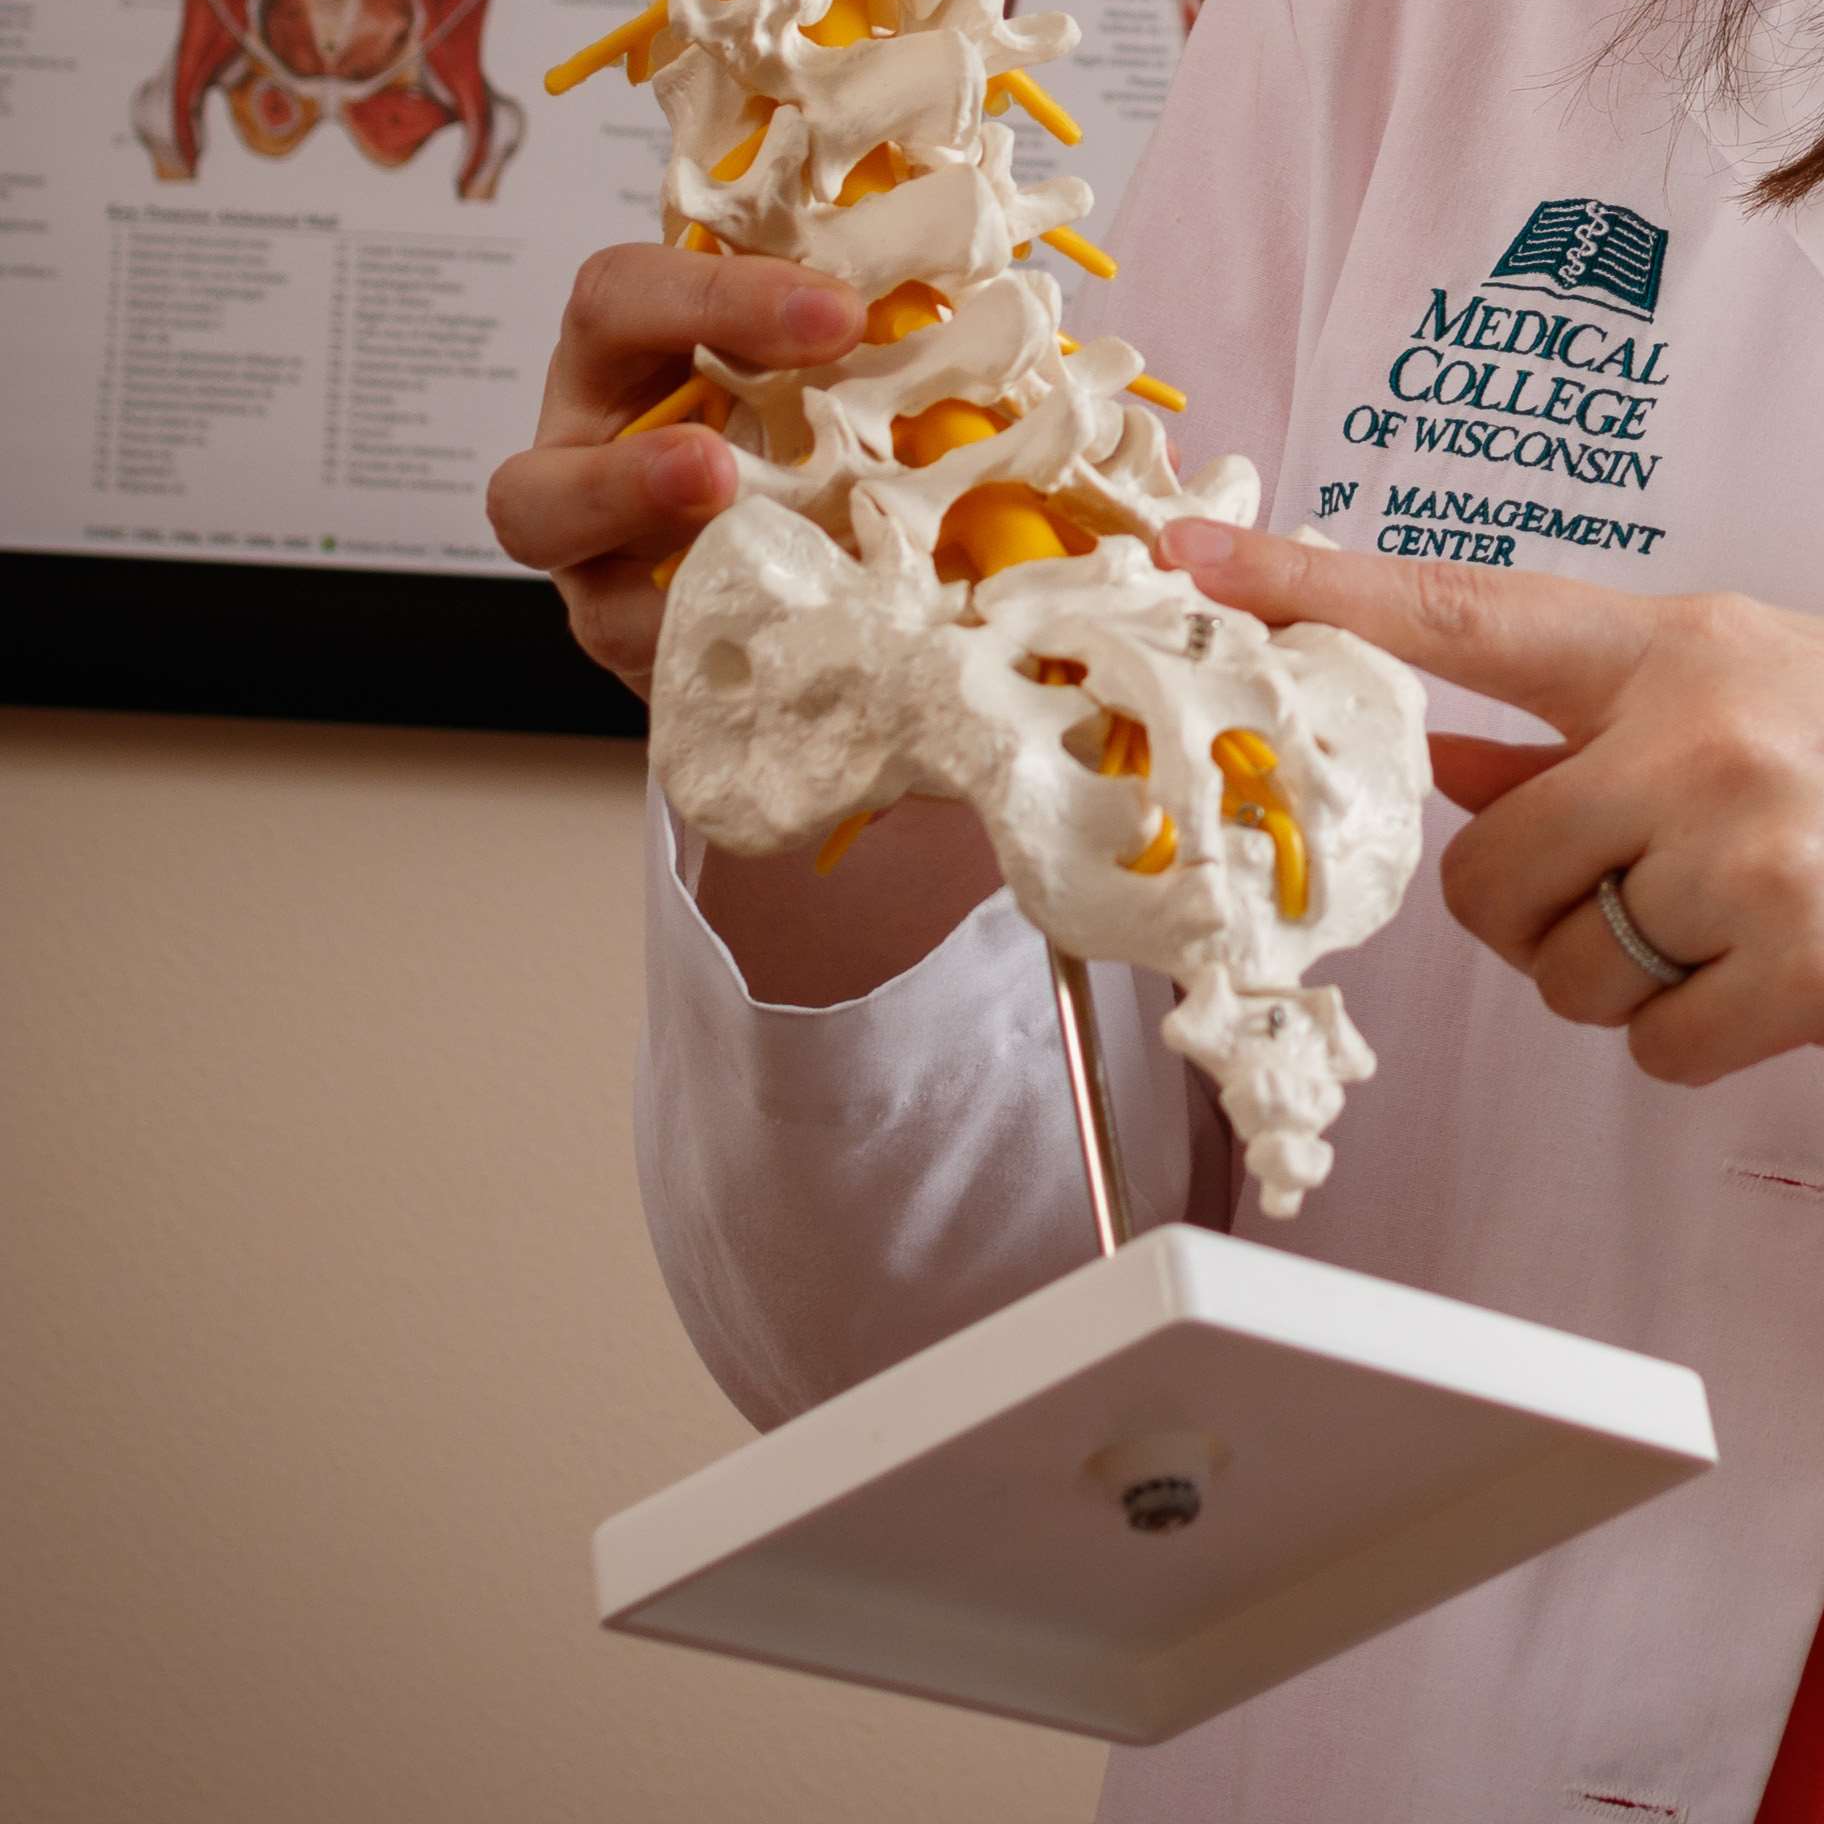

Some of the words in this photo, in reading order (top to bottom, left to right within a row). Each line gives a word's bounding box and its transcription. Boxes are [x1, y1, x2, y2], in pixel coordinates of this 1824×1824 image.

[1411, 288, 1670, 386] MEDICAL
[1388, 345, 1657, 440] COLLEGE
[1343, 405, 1407, 448] OF
[1414, 416, 1663, 491] WISCONSIN
[1377, 524, 1517, 567] CENTER
[1383, 484, 1665, 555] MANAGEMENT
